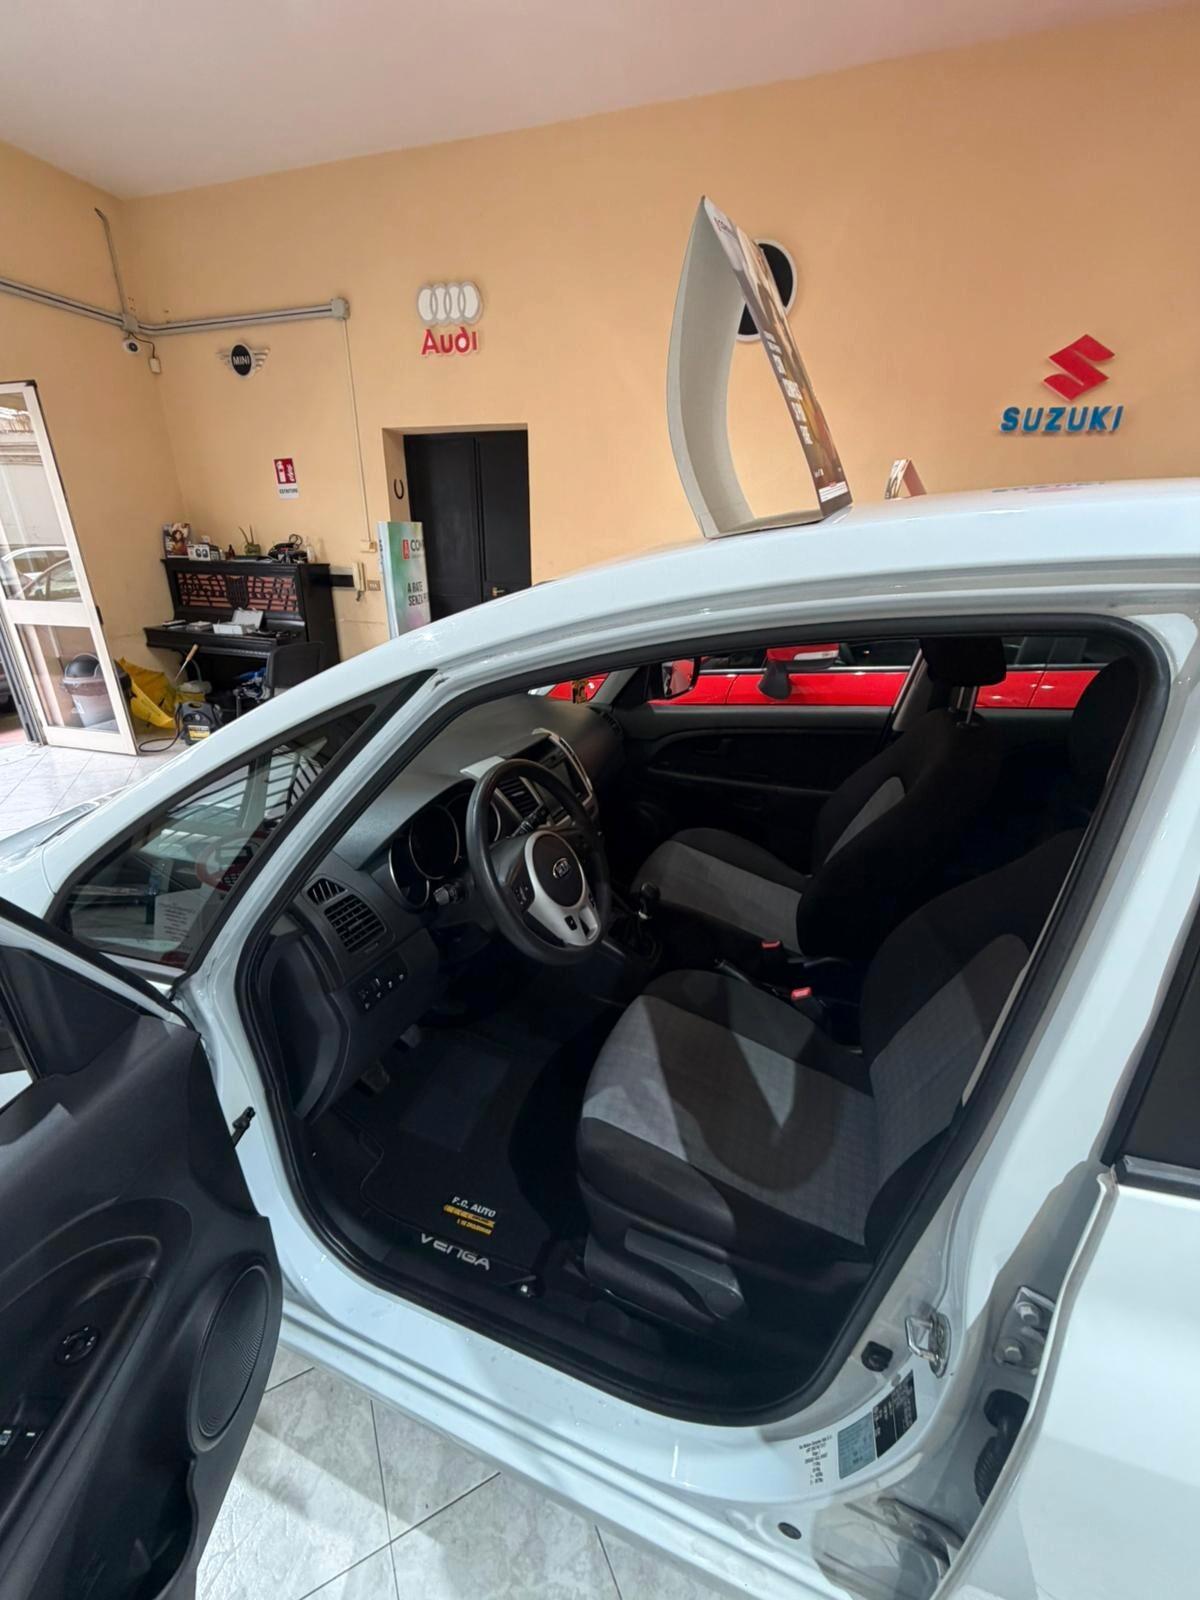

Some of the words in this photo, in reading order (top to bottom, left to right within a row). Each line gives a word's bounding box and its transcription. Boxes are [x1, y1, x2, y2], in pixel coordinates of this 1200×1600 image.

[421, 326, 478, 355] Audi
[232, 355, 250, 366] MINI
[1000, 405, 1124, 433] SUZUKI
[470, 1203, 497, 1217] AUTO
